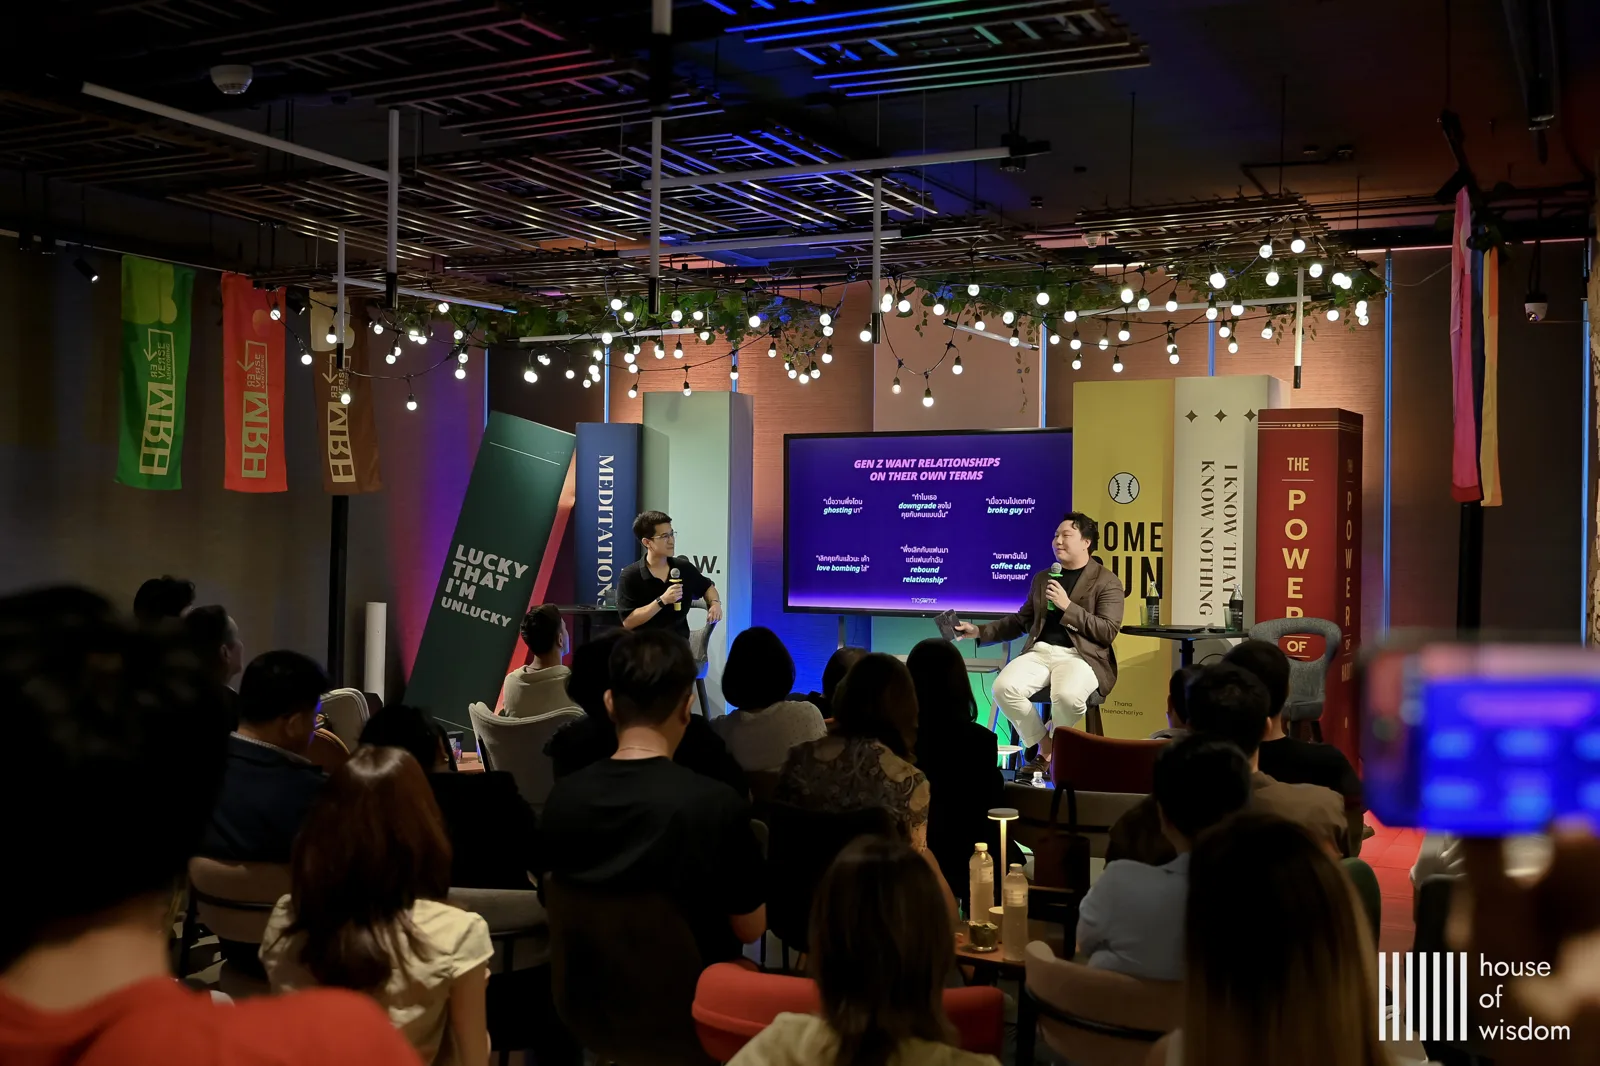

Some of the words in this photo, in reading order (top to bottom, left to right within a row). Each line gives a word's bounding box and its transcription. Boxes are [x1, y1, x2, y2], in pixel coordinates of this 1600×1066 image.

[854, 459, 875, 469] GEN
[876, 459, 884, 469] Z
[885, 458, 917, 468] WANT
[918, 457, 1001, 468] RELATIONSHIPS
[1287, 457, 1310, 471] THE
[869, 472, 887, 481] ON
[888, 471, 918, 481] THEIR
[919, 471, 947, 481] OWN
[949, 471, 984, 481] TERMS
[1200, 461, 1215, 520] KNOW
[823, 506, 853, 515] ghosting
[898, 502, 937, 511] downgrade
[987, 506, 1009, 514] broke
[1009, 507, 1024, 516] guy
[1223, 477, 1238, 537] KNOW
[455, 544, 529, 579] LUCKY
[831, 564, 860, 573] bombing
[990, 562, 1013, 570] coffee
[1013, 562, 1032, 570] date
[452, 560, 509, 591] THAT
[1091, 556, 1163, 600] UN
[1199, 526, 1214, 616] NOTHING
[445, 577, 477, 600] I'M
[441, 596, 512, 627] UNLUCKY
[1286, 640, 1307, 653] OF
